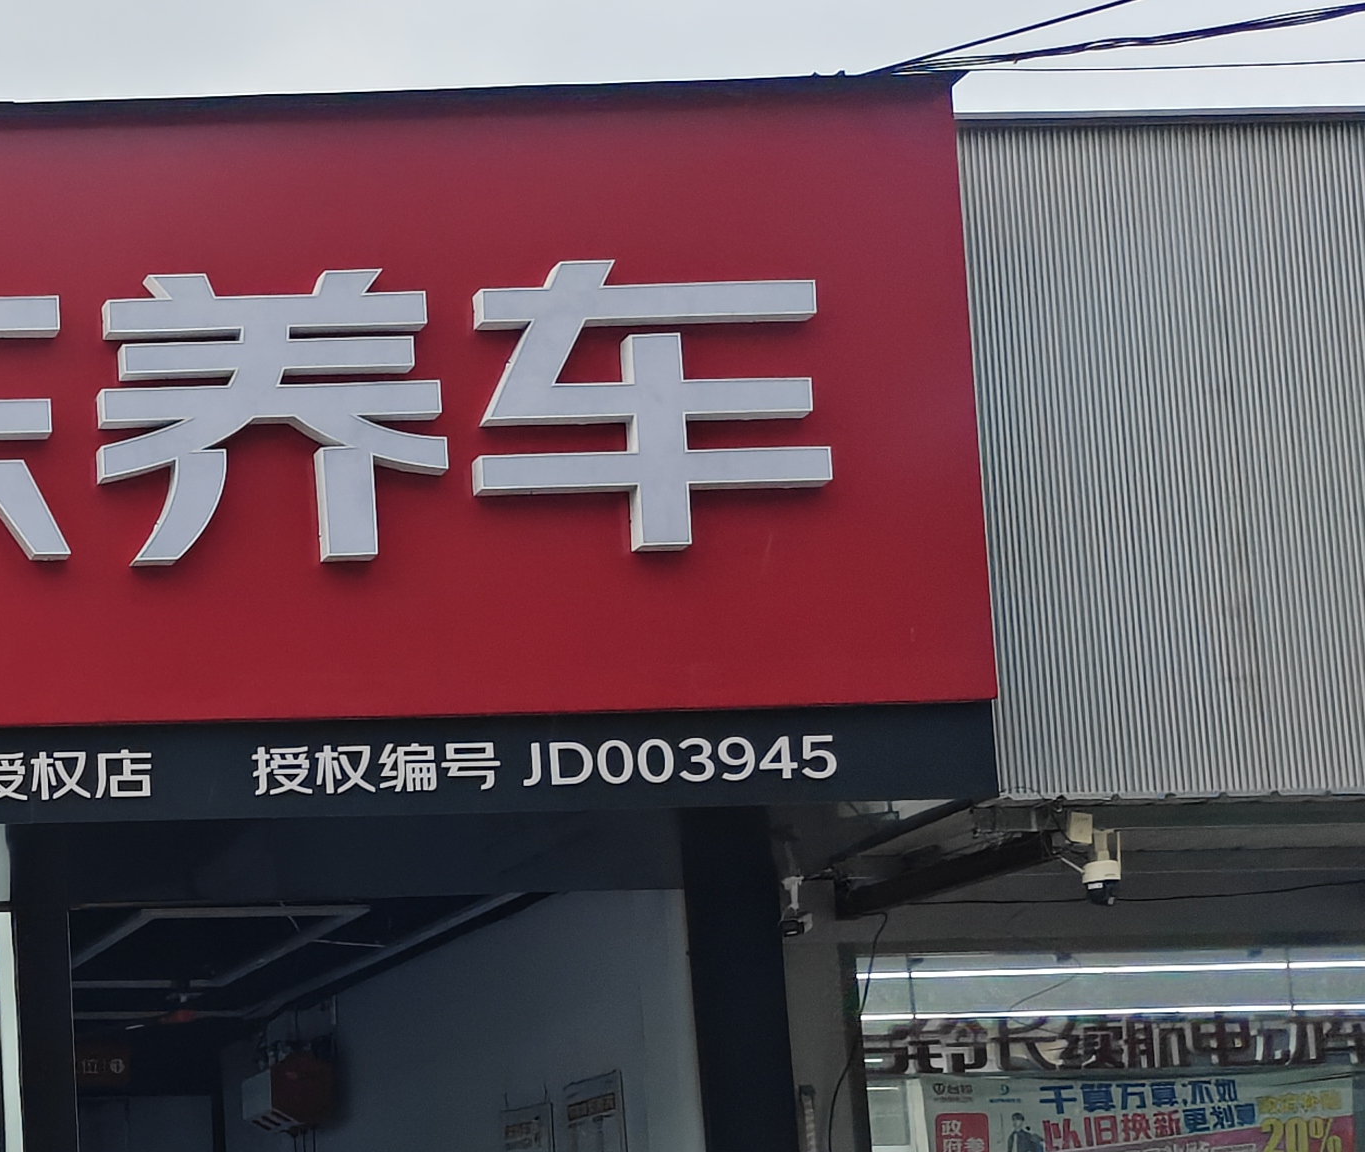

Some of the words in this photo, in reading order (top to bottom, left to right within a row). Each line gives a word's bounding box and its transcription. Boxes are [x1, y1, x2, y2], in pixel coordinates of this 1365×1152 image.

[251, 742, 501, 796] 授权编号
[523, 734, 838, 787] JD003945
